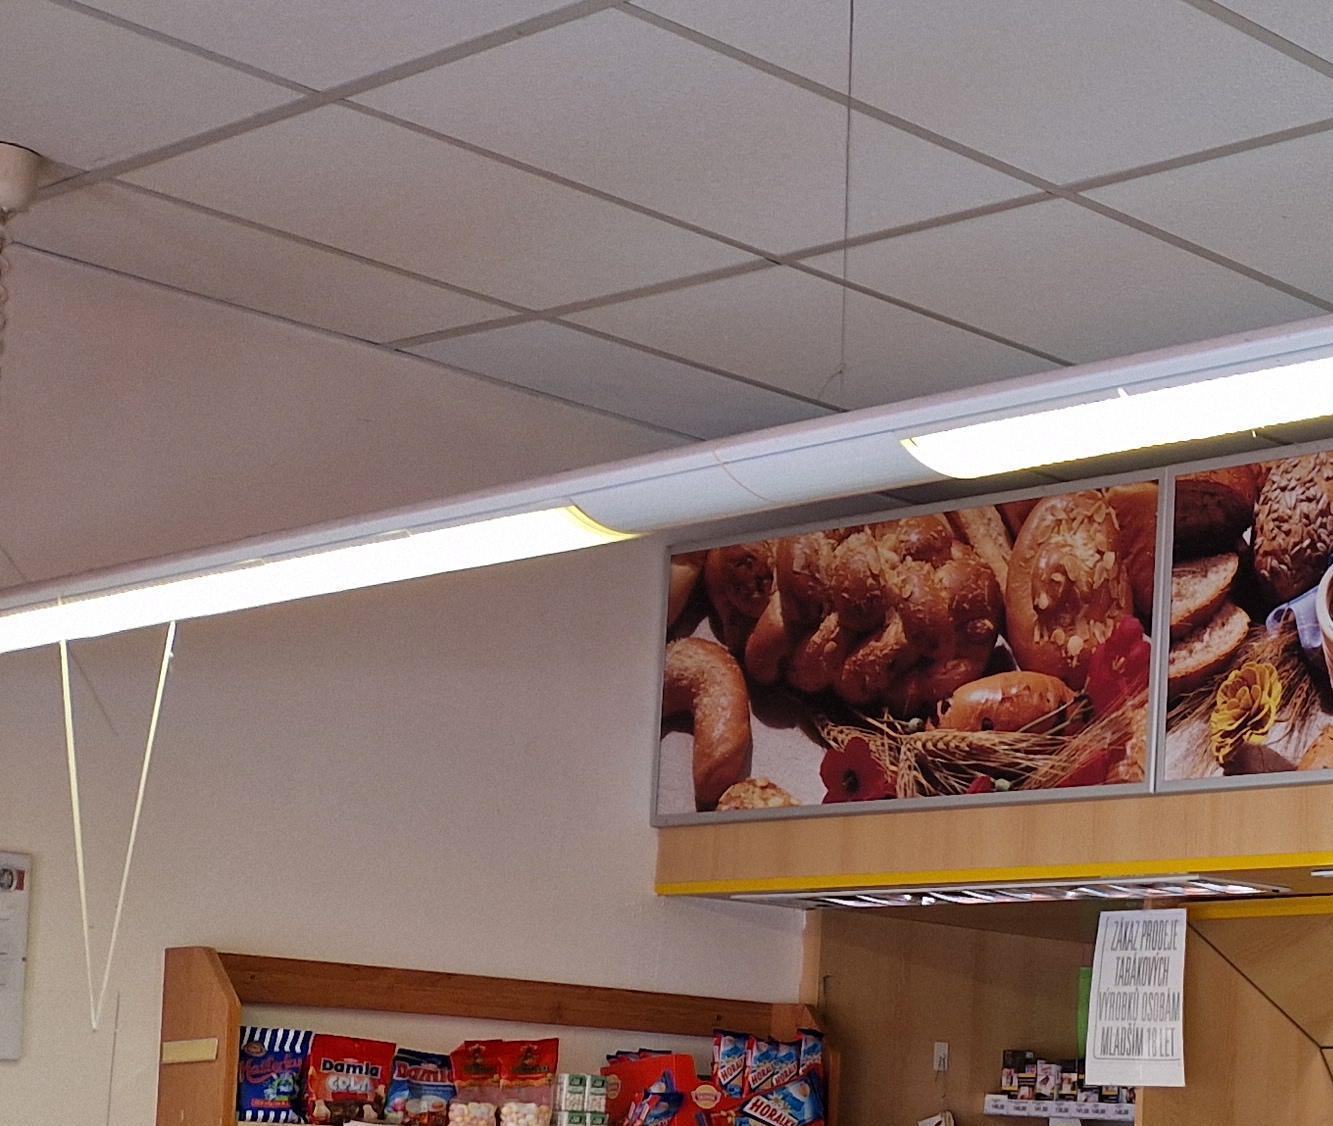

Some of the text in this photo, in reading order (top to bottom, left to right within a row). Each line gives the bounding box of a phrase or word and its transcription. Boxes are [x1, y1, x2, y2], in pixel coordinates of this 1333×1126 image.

[1111, 917, 1178, 951] ZÁKAZ PRODEJE
[1114, 952, 1169, 987] TABÁKOVÝCH
[1100, 987, 1179, 1021] VÝROBKŮ OSOBÁM
[1100, 1024, 1175, 1056] MLADŠÍM 18 LET
[321, 1058, 381, 1078] Damla
[327, 1076, 371, 1092] COLA
